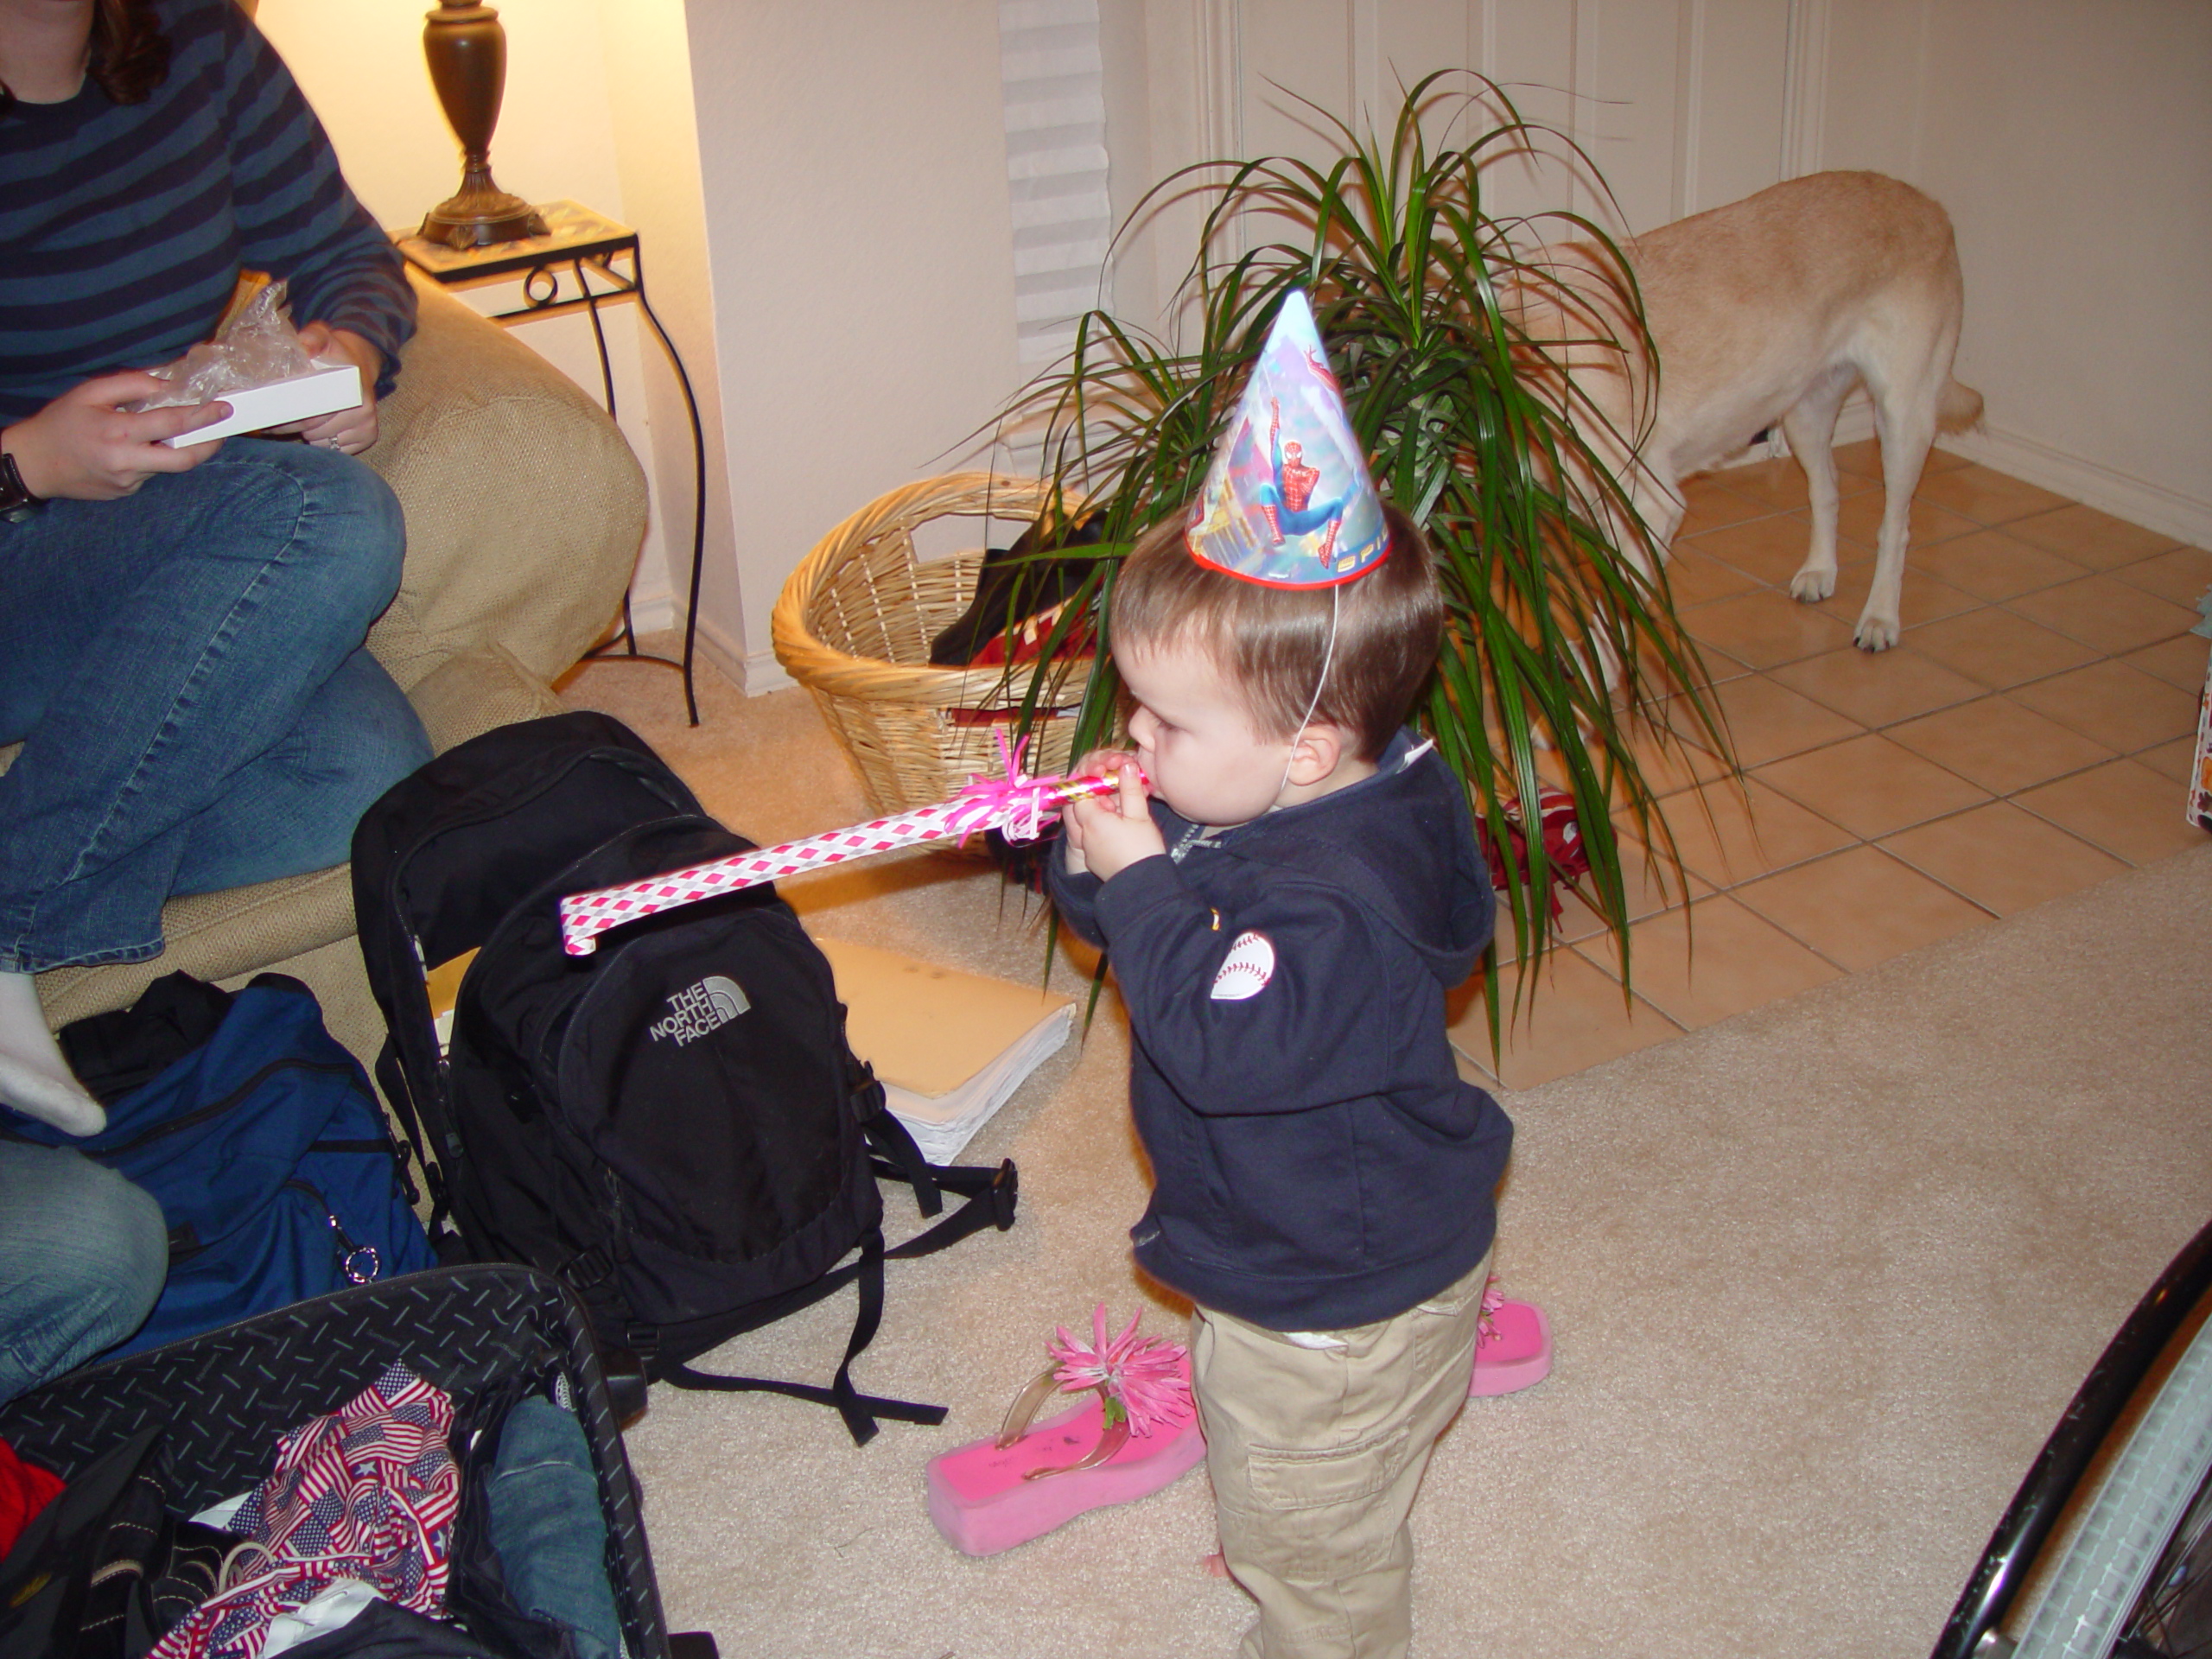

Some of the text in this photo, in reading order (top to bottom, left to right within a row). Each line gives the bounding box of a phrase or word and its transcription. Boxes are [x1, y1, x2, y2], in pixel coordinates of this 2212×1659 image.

[666, 982, 707, 1012] THE
[650, 996, 714, 1042] NORTH
[674, 1011, 721, 1047] FACE
